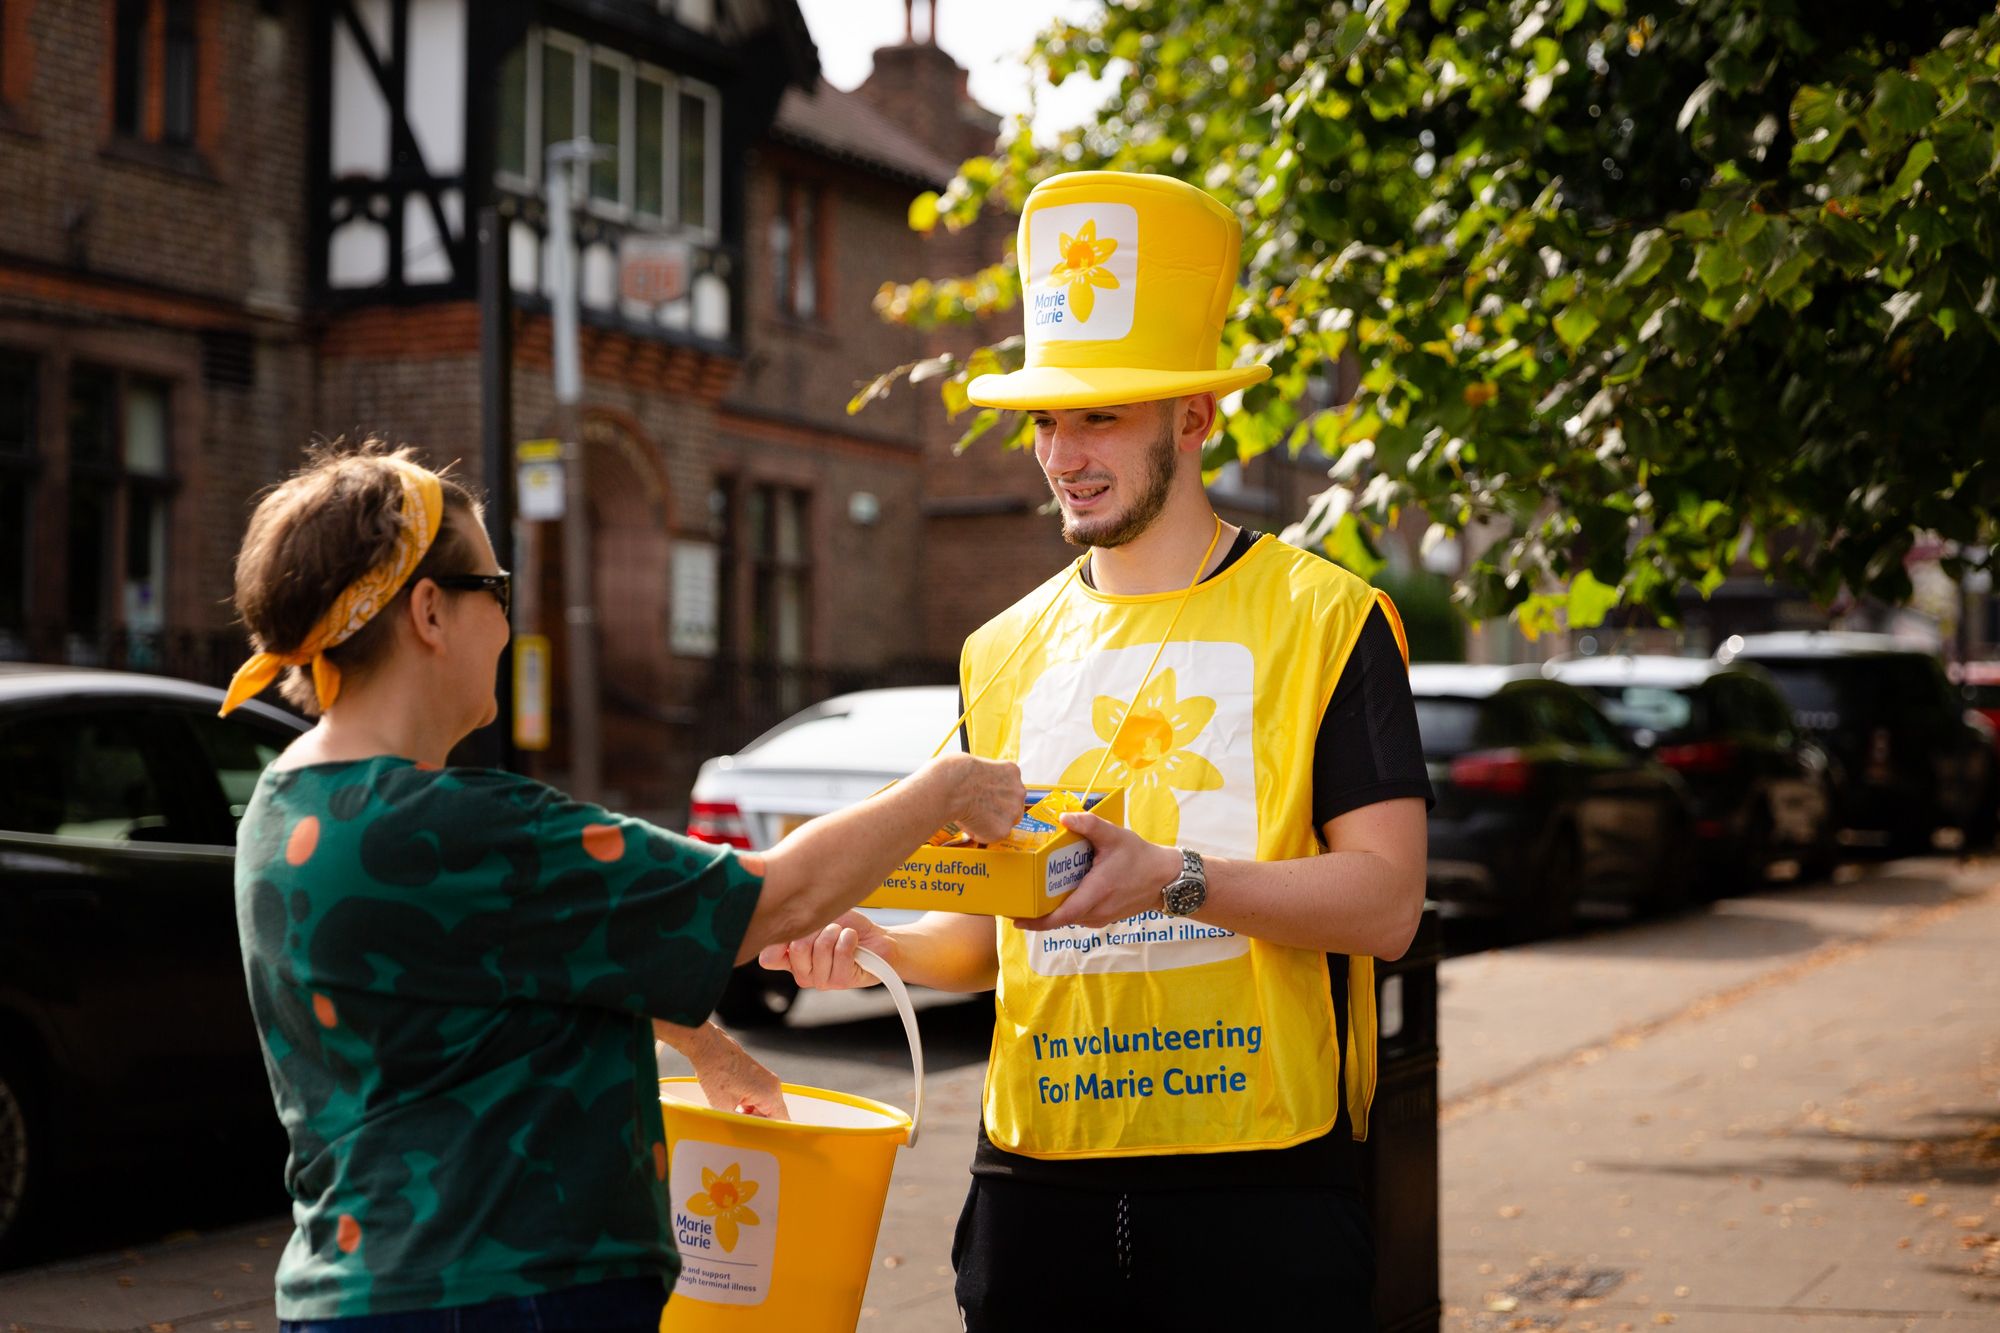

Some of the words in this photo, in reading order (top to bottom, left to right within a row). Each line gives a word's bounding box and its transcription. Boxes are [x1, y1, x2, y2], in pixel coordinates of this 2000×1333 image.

[1034, 291, 1065, 309] Marie
[1035, 308, 1063, 325] Curie
[935, 860, 990, 878] daffodil,
[1049, 856, 1072, 878] Marie
[920, 881, 927, 890] a
[931, 879, 965, 896] story
[1043, 932, 1101, 952] through
[1106, 925, 1173, 945] terminal
[1032, 1032, 1068, 1060] I'm
[1073, 1019, 1262, 1054] volunteering
[1038, 1076, 1069, 1104] for
[1074, 1069, 1153, 1101] Marie
[1163, 1065, 1247, 1095] Curie
[676, 1213, 712, 1235] Marie
[678, 1229, 711, 1249] Curie
[687, 1265, 700, 1275] and
[702, 1270, 731, 1280] support
[680, 1274, 697, 1285] ough
[698, 1278, 730, 1289] terminal
[731, 1282, 757, 1292] illness
